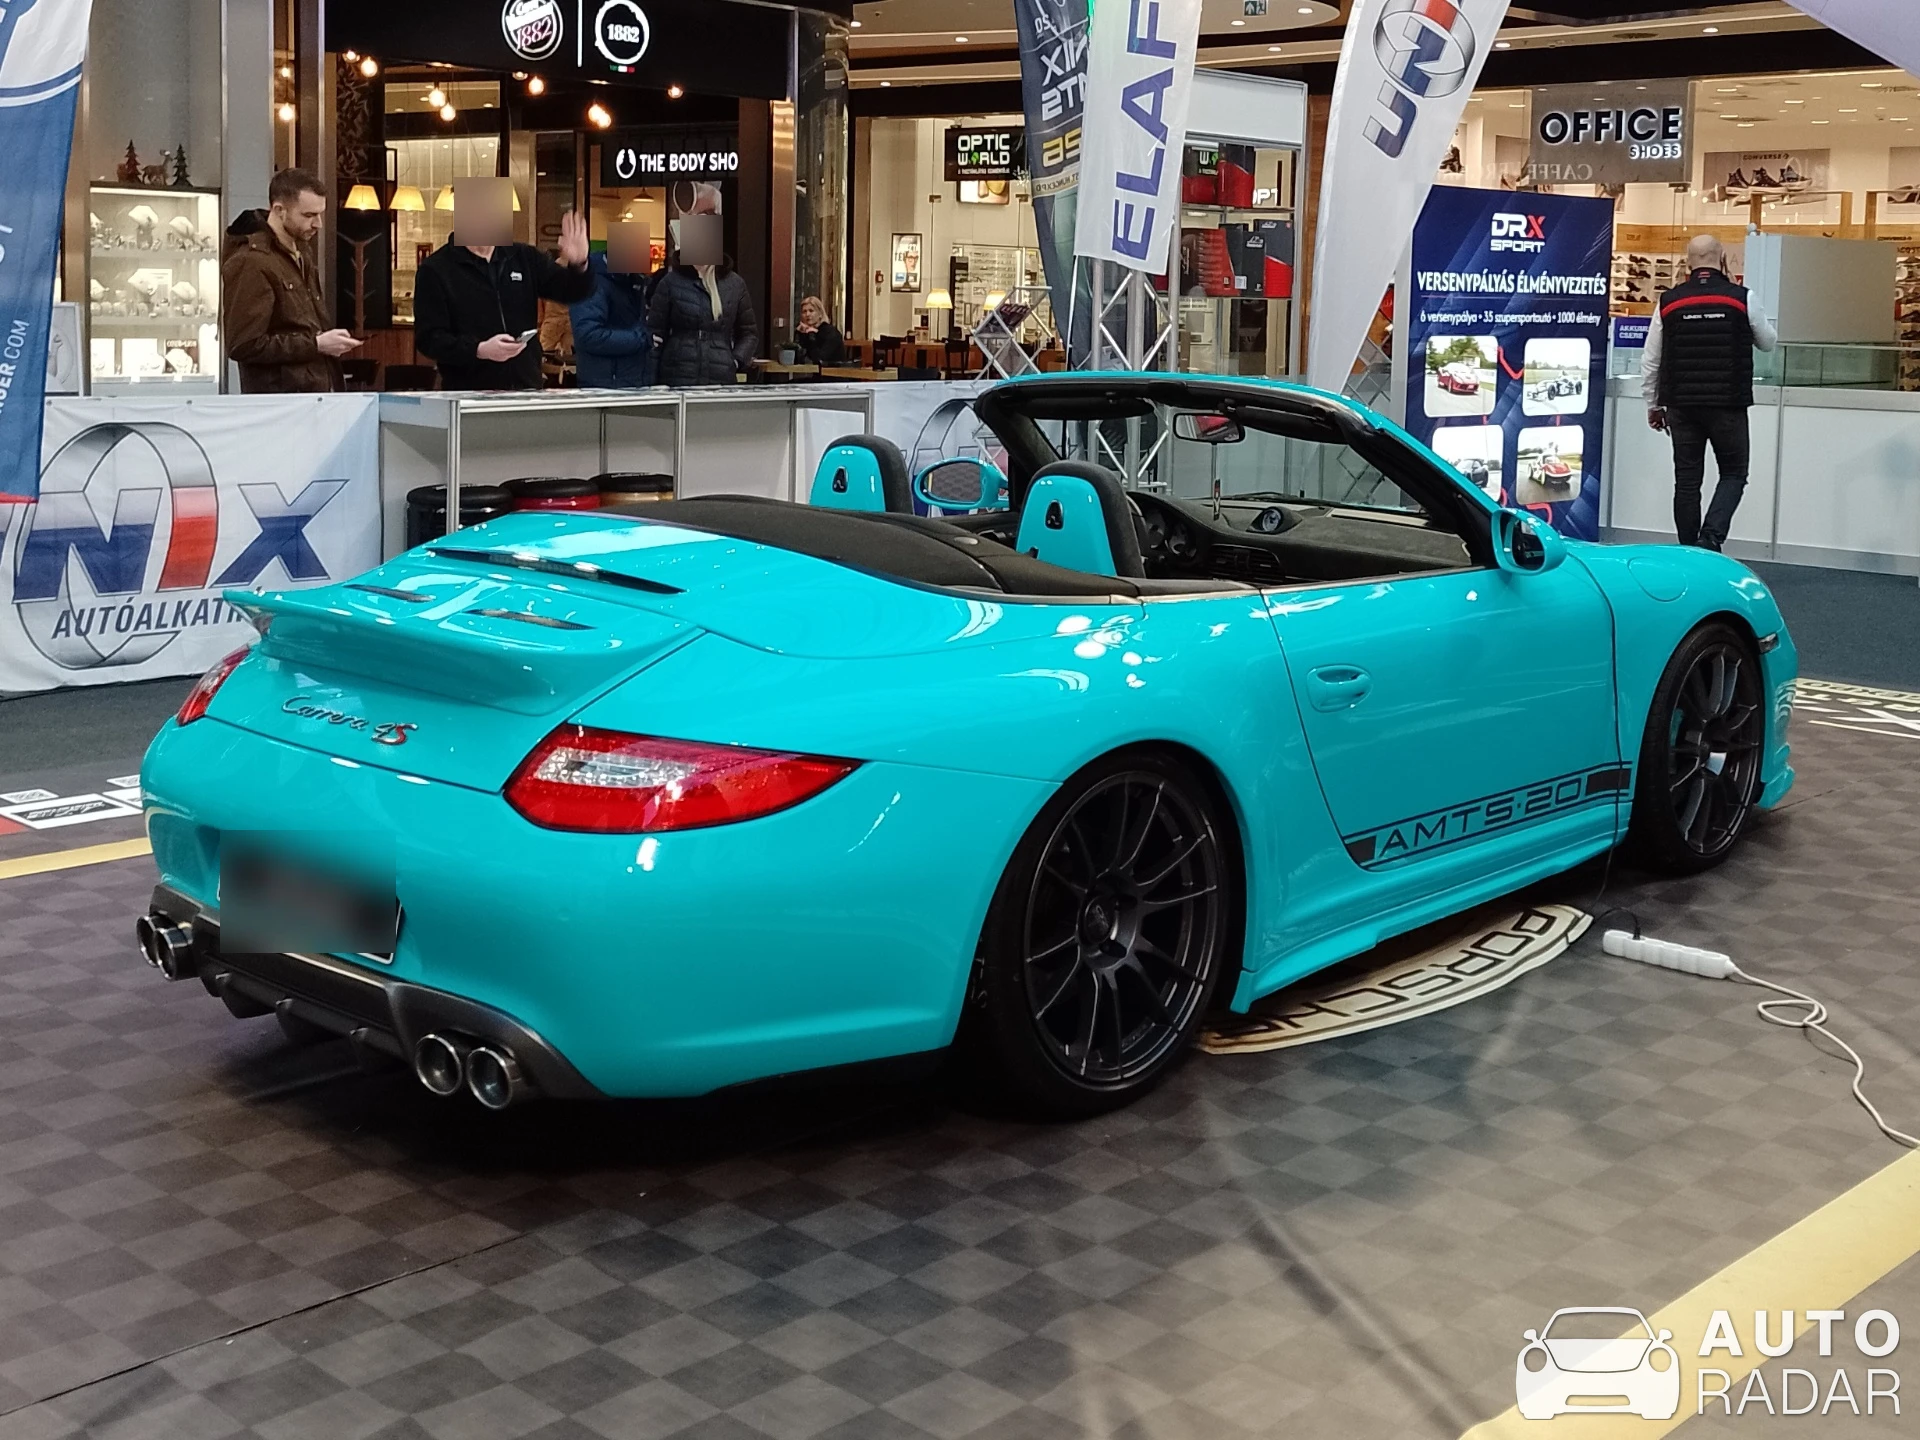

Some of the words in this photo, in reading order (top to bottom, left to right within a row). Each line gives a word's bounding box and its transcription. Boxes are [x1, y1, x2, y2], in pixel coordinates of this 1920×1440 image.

[516, 16, 552, 50] 1882
[607, 23, 640, 43] 1882
[1540, 108, 1682, 143] OFFICE
[957, 134, 1010, 151] OPTIC
[1629, 144, 1683, 160] SHOES
[639, 154, 666, 172] THE
[669, 153, 706, 172] BODY
[709, 152, 739, 171] SHO
[1491, 213, 1546, 239] DRX
[1490, 239, 1545, 253] SPORT
[1417, 268, 1514, 293] VERSENYPÁLYÁS
[1517, 270, 1607, 295] ÉLMÉNYVEZETÉS
[1420, 310, 1425, 322] 6
[1427, 310, 1477, 327] versenypálya
[1484, 311, 1493, 322] 35
[1495, 311, 1551, 327] szupersportautó
[1557, 312, 1574, 323] 1000
[1576, 312, 1601, 326] élmény
[0, 479, 350, 601] NIX
[282, 695, 369, 730] Carrera
[371, 722, 418, 745] 4S
